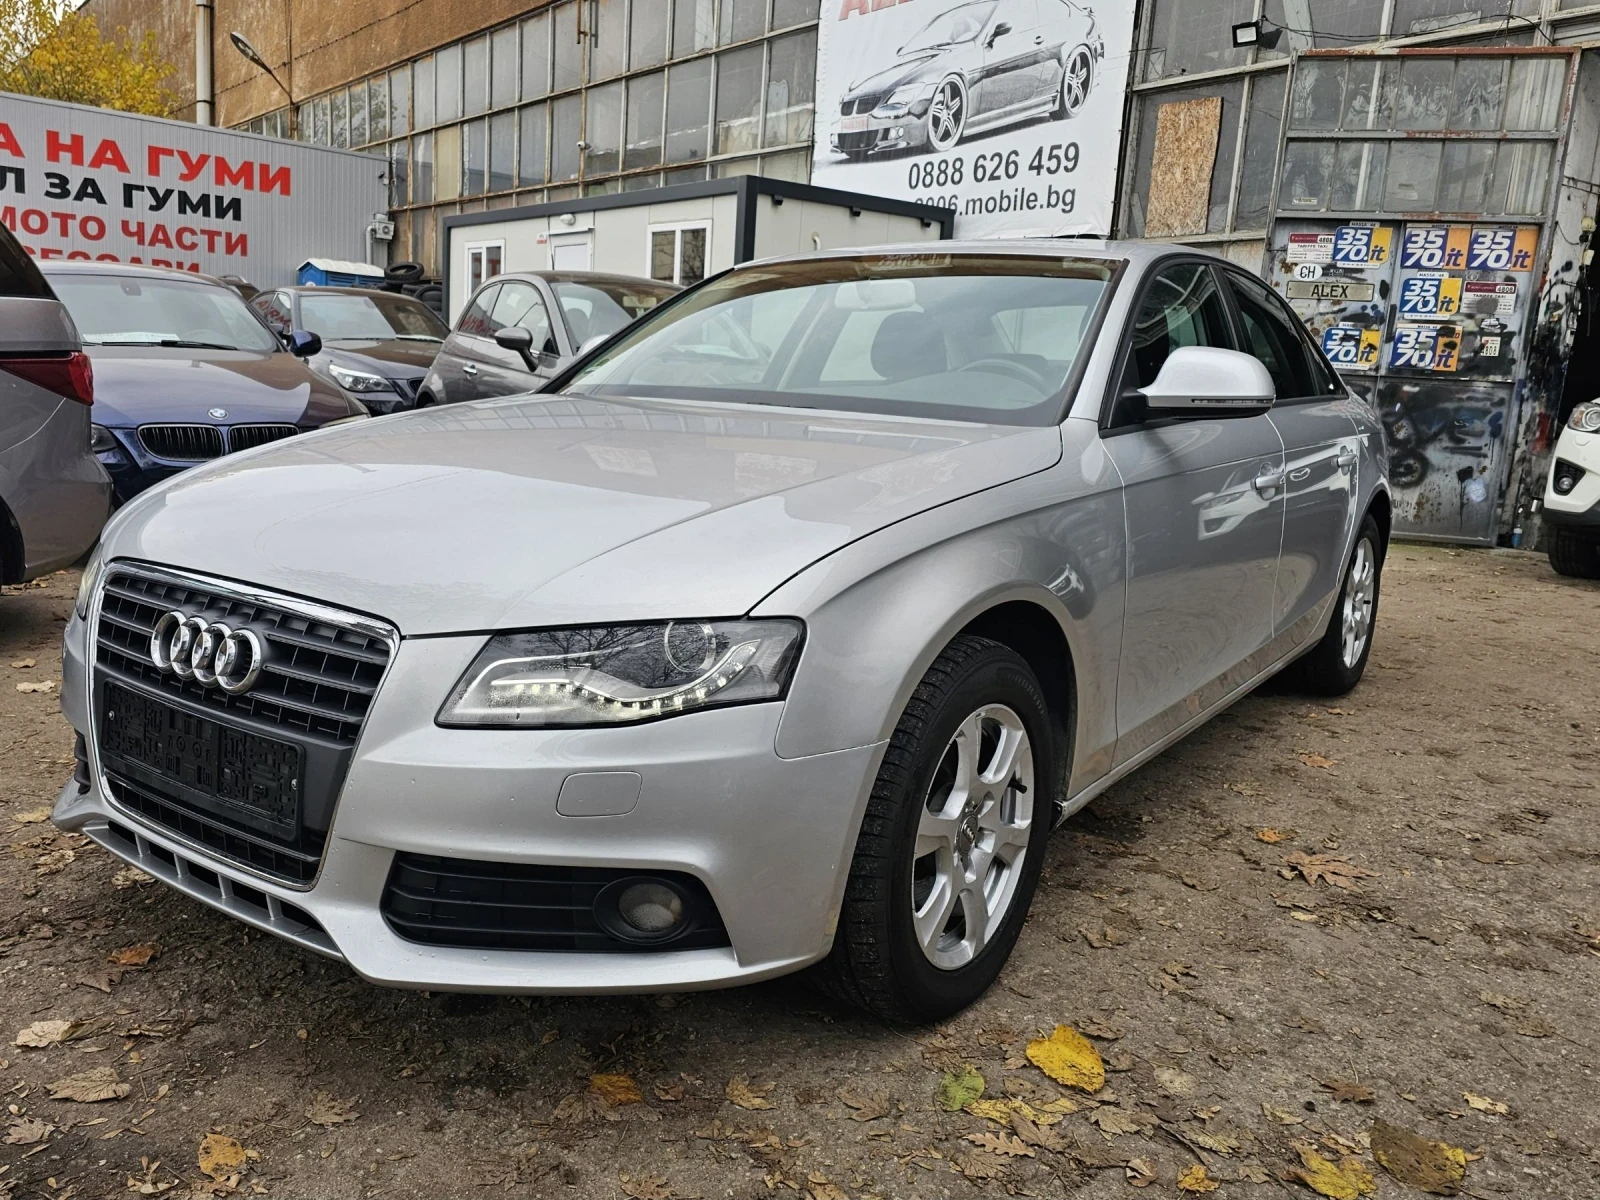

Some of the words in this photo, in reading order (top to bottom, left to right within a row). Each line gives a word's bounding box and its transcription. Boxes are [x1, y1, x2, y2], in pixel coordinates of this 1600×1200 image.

[46, 129, 131, 174] НА
[147, 145, 291, 197] ГУМИ
[908, 157, 964, 190] 0888
[973, 149, 1020, 183] 626
[1028, 142, 1080, 177] 459
[44, 172, 108, 206] ЗА
[123, 183, 242, 222] ГУМИ
[914, 184, 1077, 216] 06.mobile.bg
[121, 219, 248, 257] ЧАСТИ
[1337, 228, 1371, 245] 35
[1406, 230, 1446, 249] 35
[1473, 231, 1513, 250] 35
[1300, 265, 1316, 279] CH
[1311, 284, 1349, 299] ALEX
[1403, 279, 1440, 297] 35
[1397, 330, 1437, 349] 35
